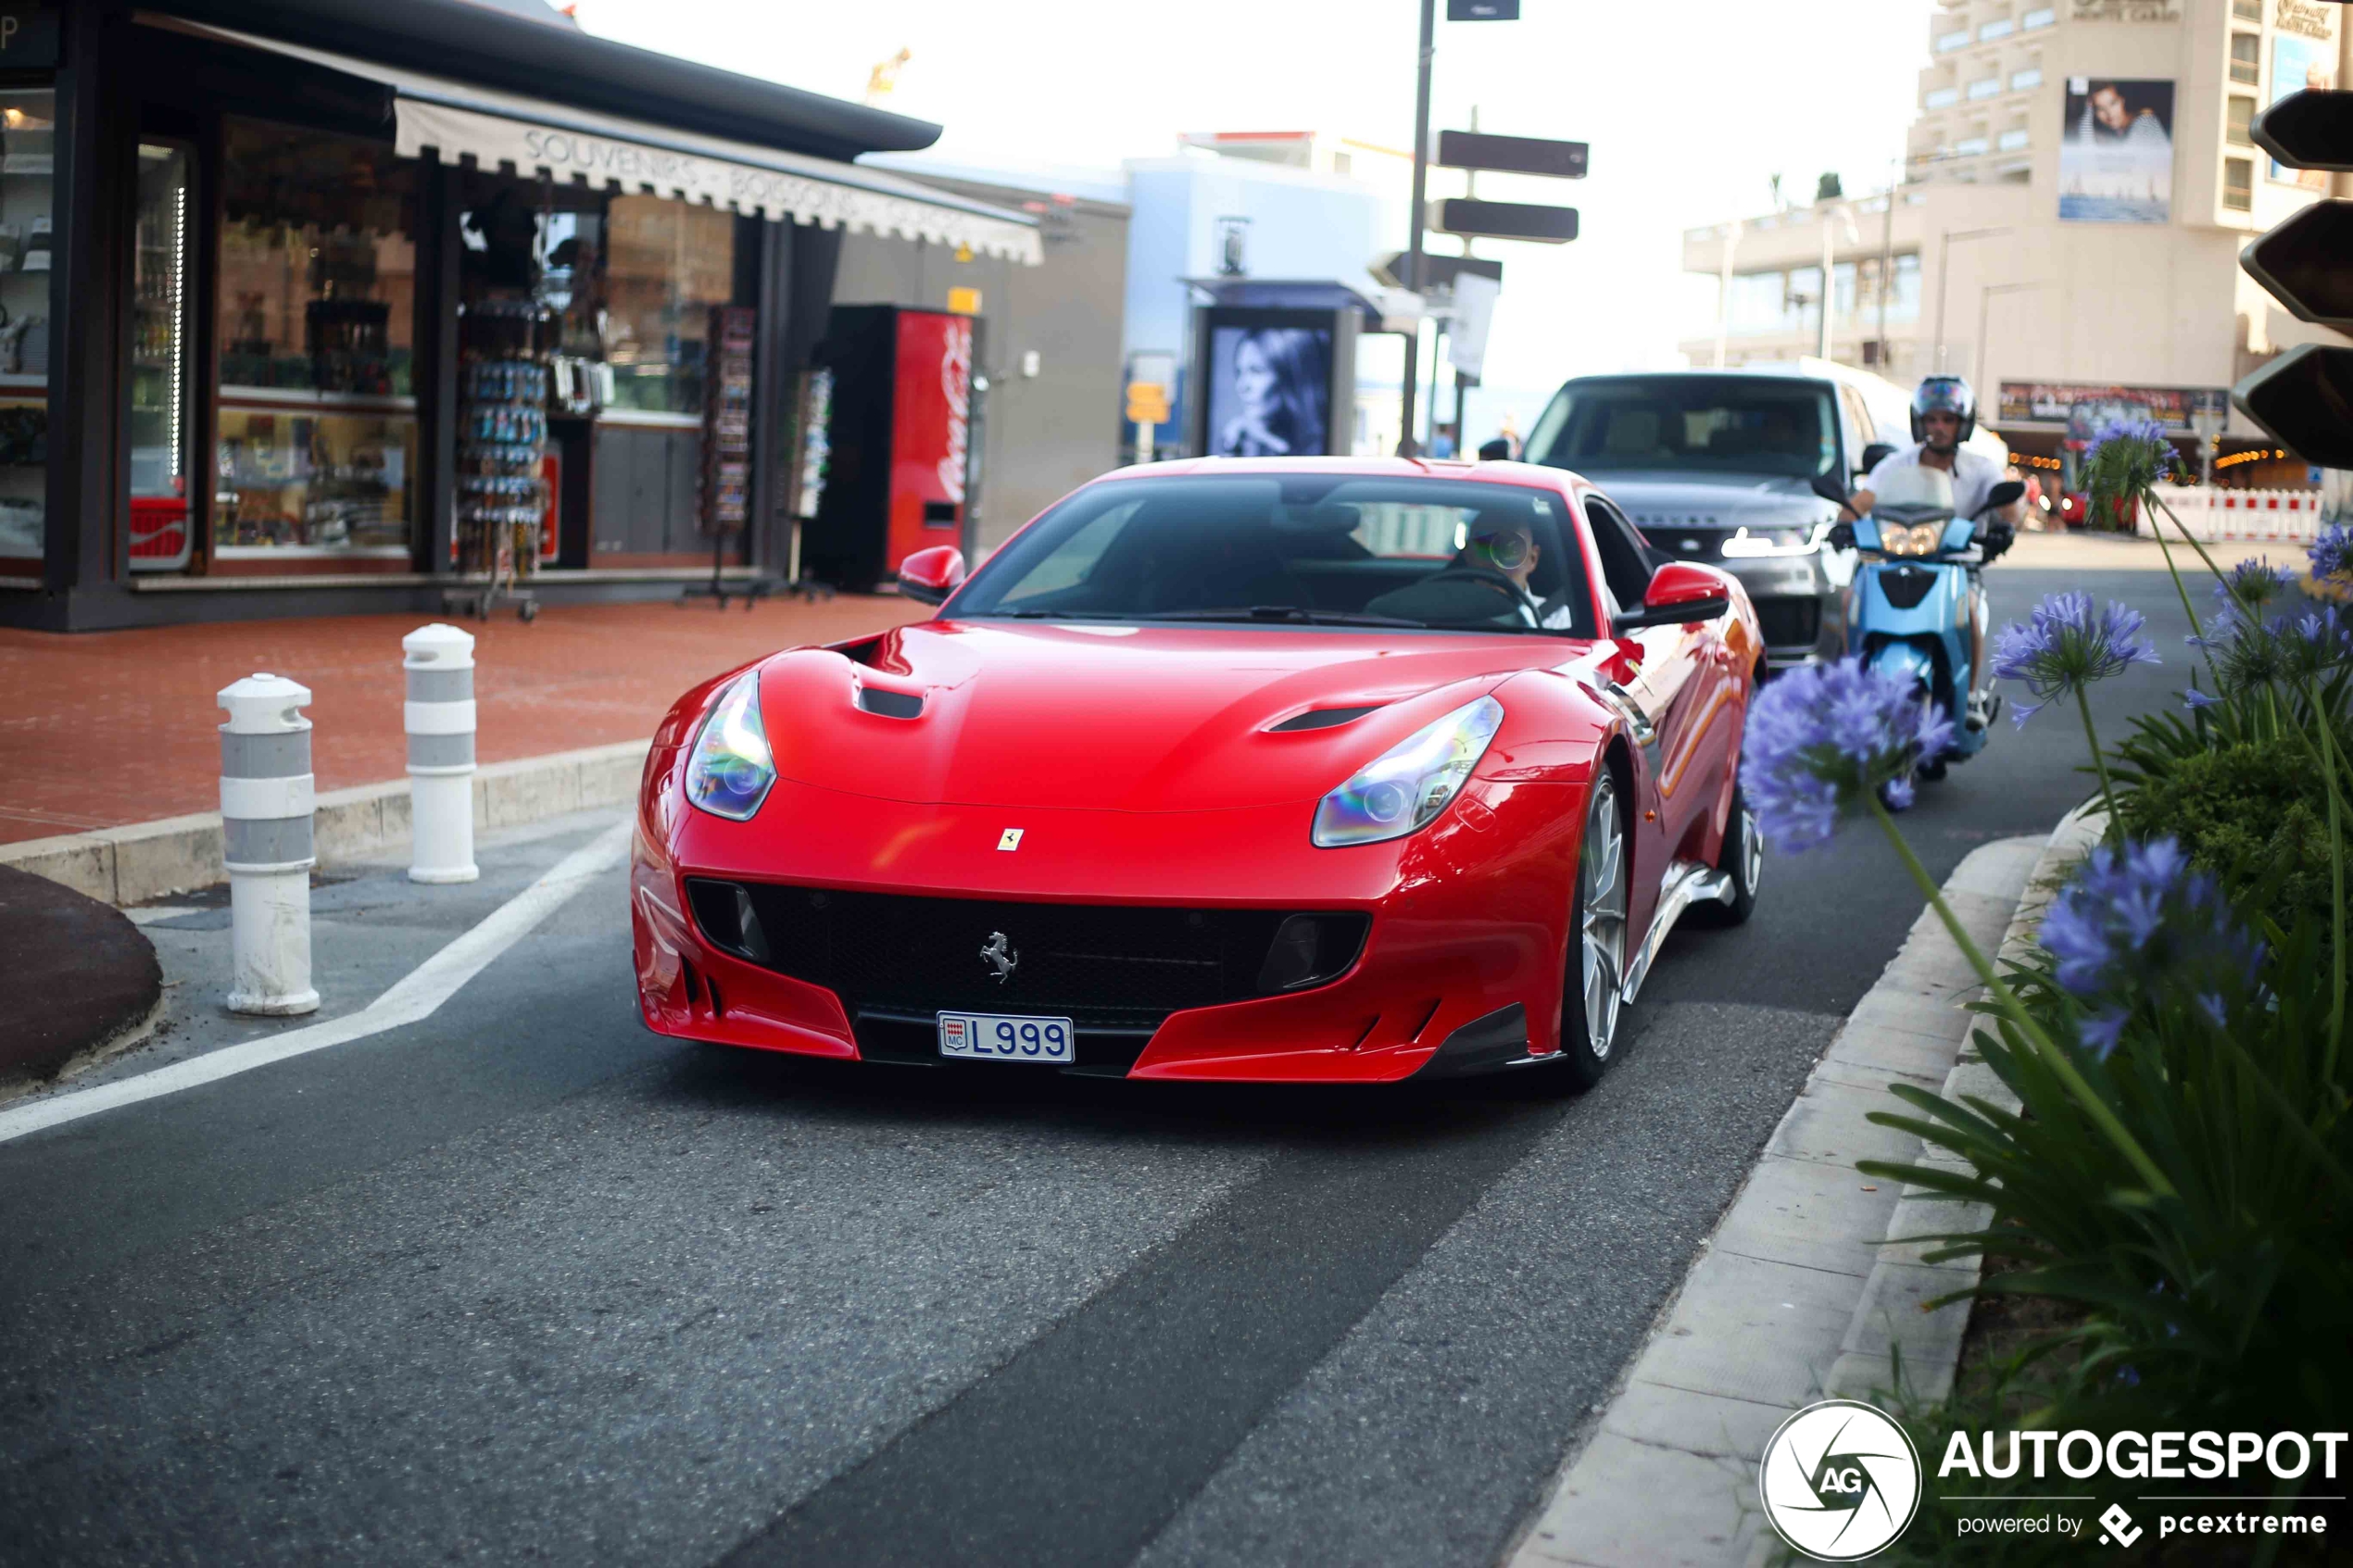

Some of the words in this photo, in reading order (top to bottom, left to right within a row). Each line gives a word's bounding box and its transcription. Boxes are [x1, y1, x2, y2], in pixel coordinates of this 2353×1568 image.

[524, 130, 698, 186] SOUVENIRS
[948, 1035, 963, 1046] MC
[972, 1020, 1064, 1056] L999
